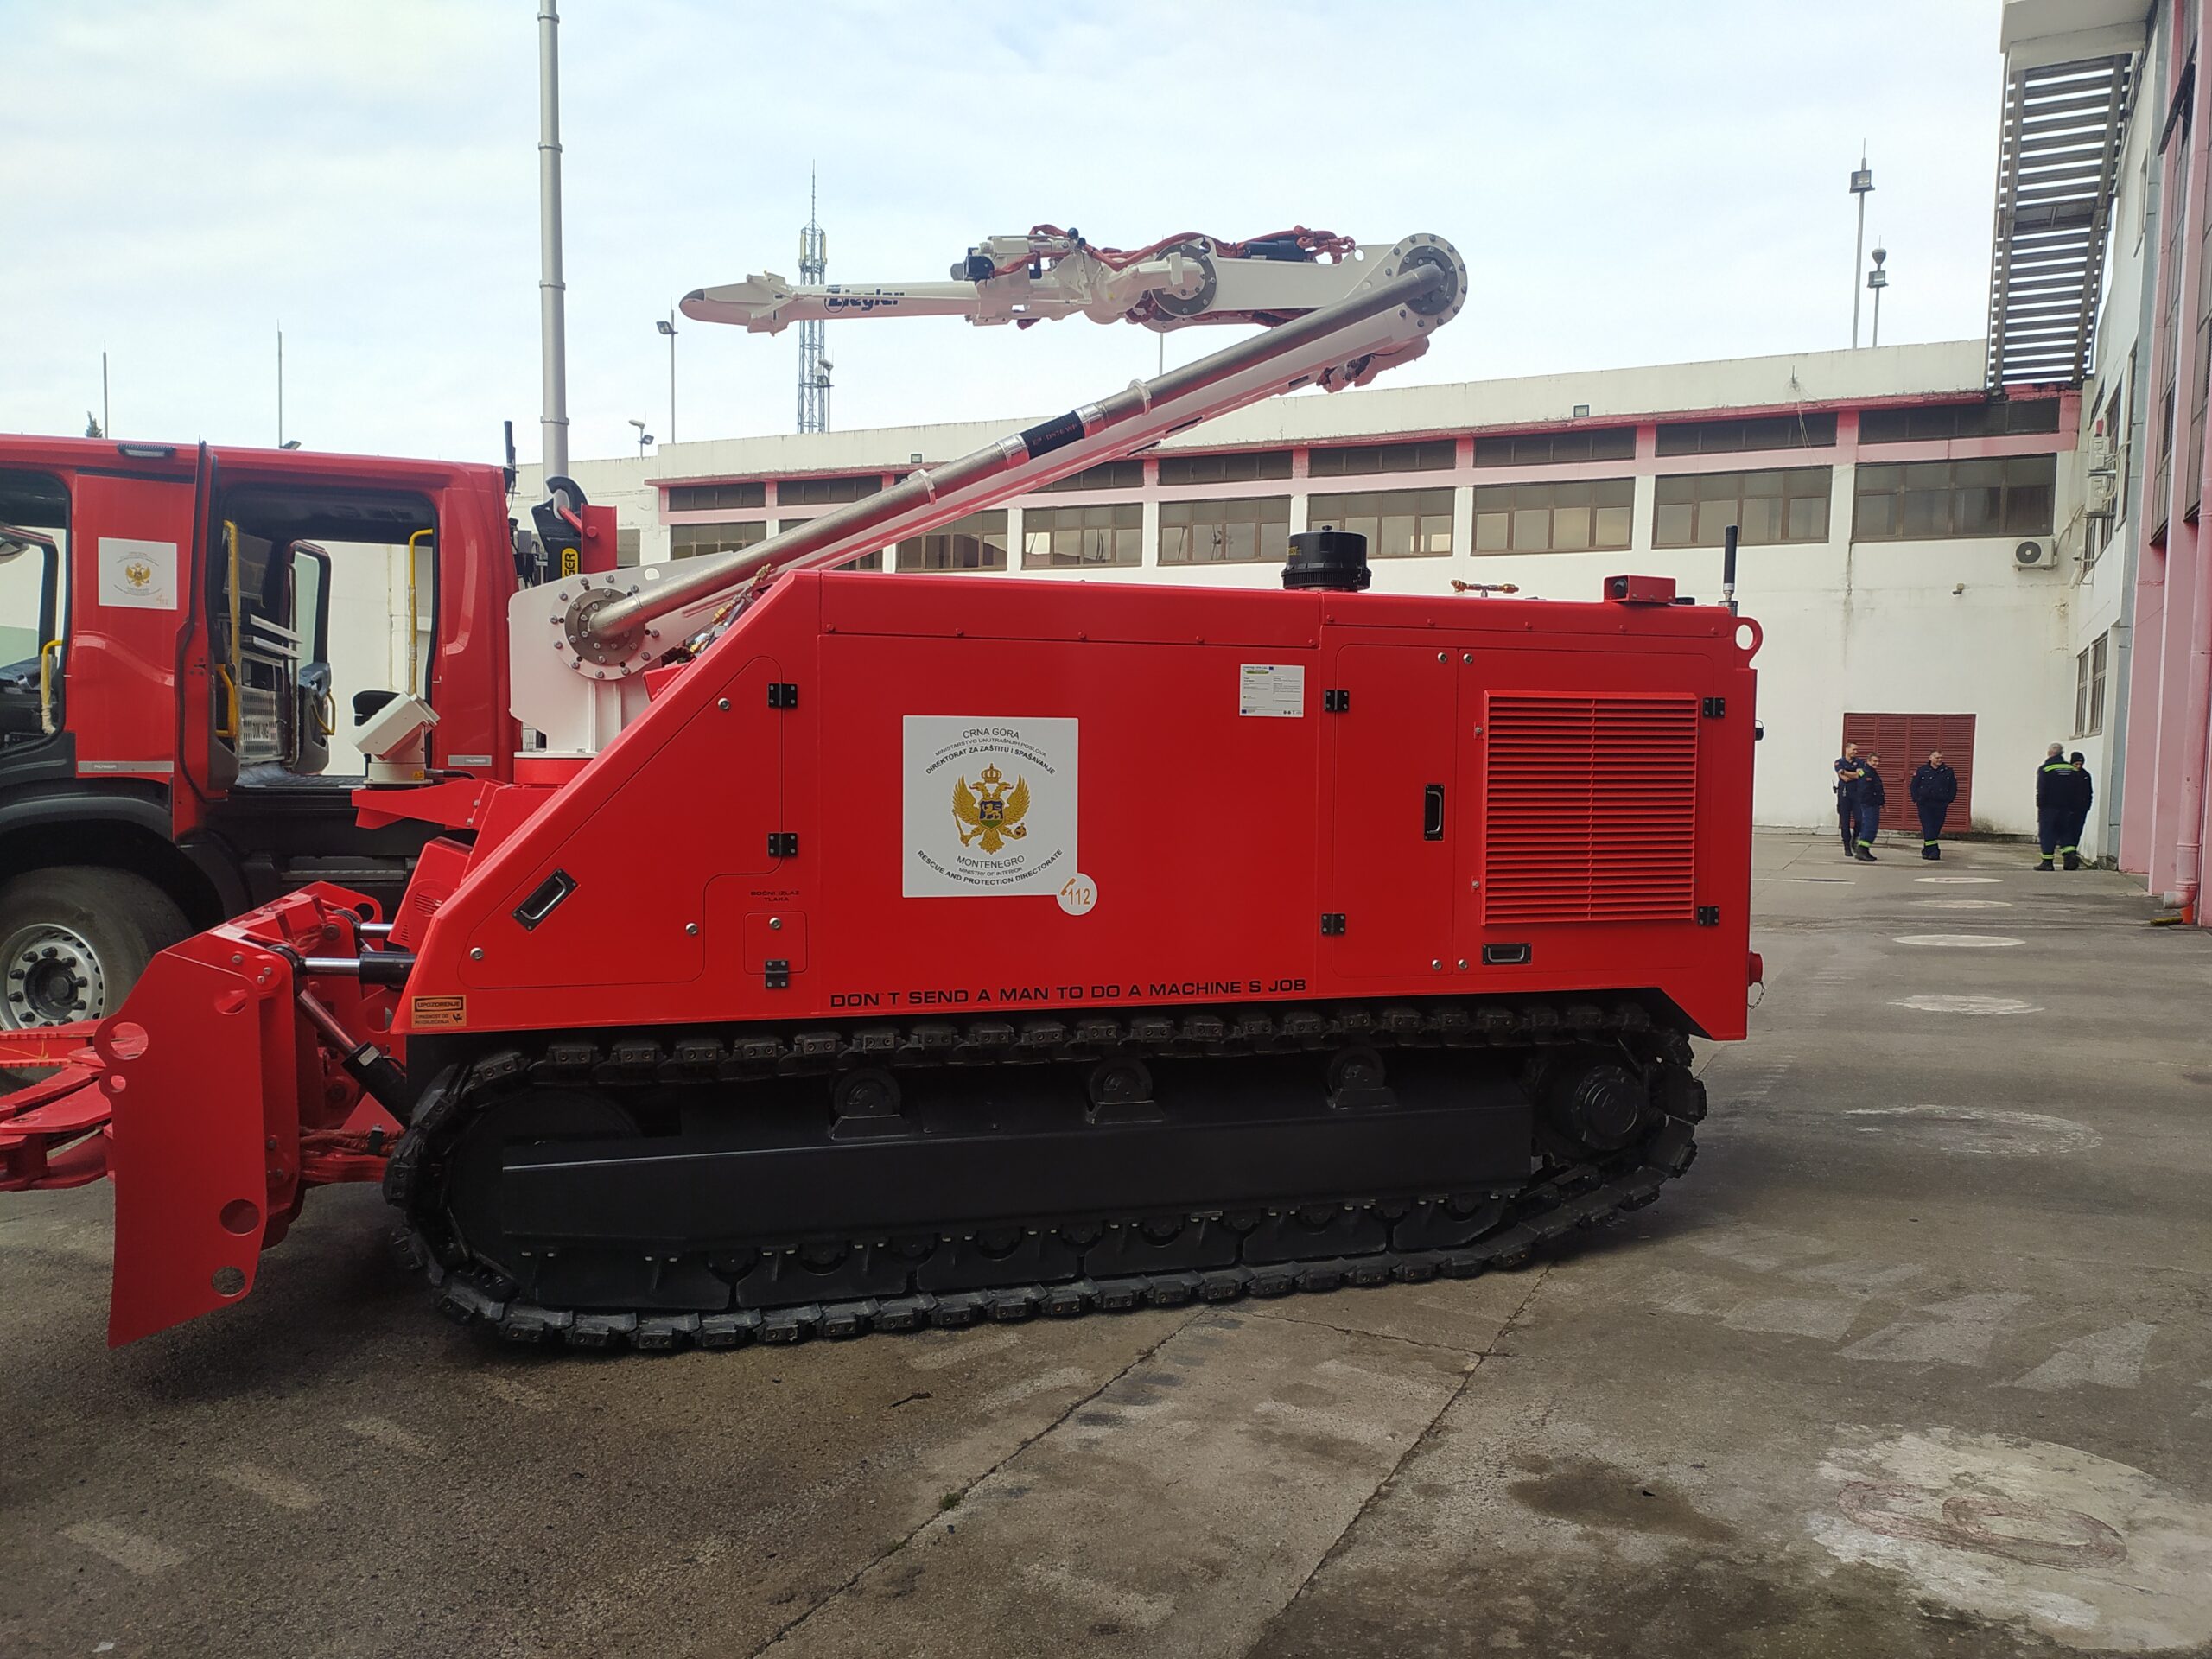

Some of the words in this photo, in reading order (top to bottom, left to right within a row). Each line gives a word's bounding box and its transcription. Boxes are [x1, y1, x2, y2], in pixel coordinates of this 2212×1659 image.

[826, 284, 905, 312] Ziegler
[963, 728, 990, 739] CRNA
[992, 728, 1020, 740] GORA
[935, 738, 977, 756] MINISTARSTVO
[978, 737, 1020, 746] UNUTRAŠNJIH
[1020, 742, 1046, 757] POSLOVA
[925, 748, 967, 774] DIREKTORAT
[979, 744, 1009, 753] ZAŠTITU
[1014, 748, 1056, 775] SPAŠAVANJE
[918, 849, 945, 874] RESCUE
[945, 871, 962, 880] AND
[963, 876, 1014, 886] PROTECTION
[1014, 849, 1063, 881] DIRECTORATE
[957, 855, 1025, 869] MONTENEGRO
[958, 867, 985, 876] MINISTRY
[995, 867, 1023, 876] INTERIOR
[1068, 887, 1090, 905] 112
[908, 988, 969, 1005] SEND
[976, 988, 992, 1002] A
[999, 986, 1049, 1002] MAN
[1056, 986, 1084, 1000] TO
[1090, 984, 1121, 998] DO
[1128, 984, 1142, 997] A
[1268, 978, 1306, 993] JOB
